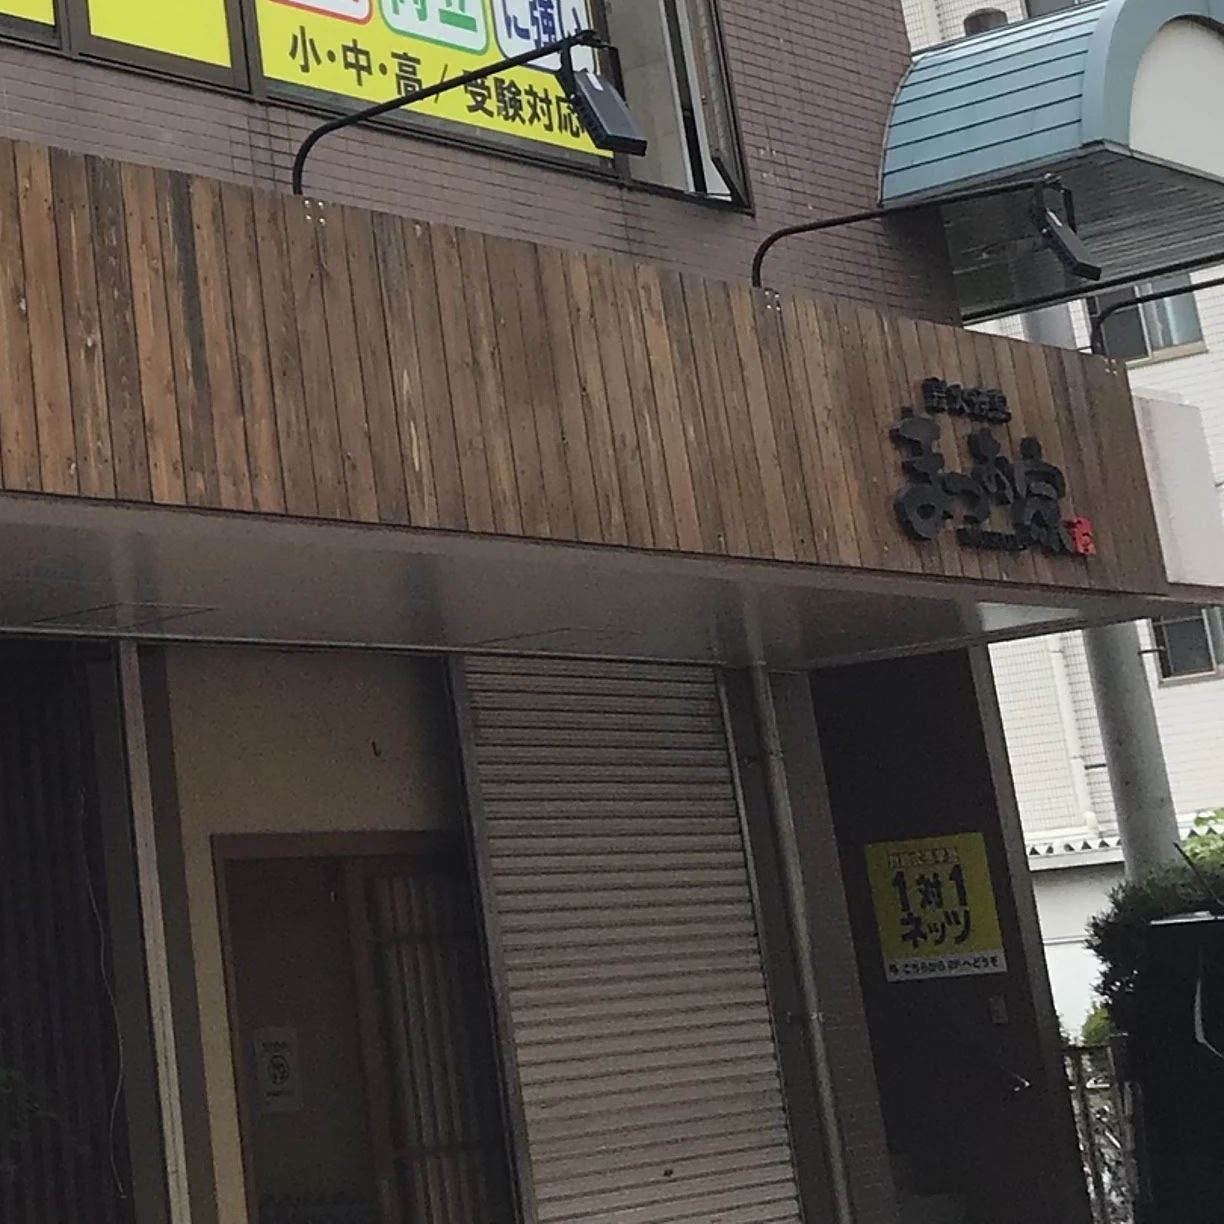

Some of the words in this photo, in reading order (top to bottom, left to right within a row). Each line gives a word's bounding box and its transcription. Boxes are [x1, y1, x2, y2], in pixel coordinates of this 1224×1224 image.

[891, 863, 969, 913] 1対1
[899, 909, 972, 950] ネッツ
